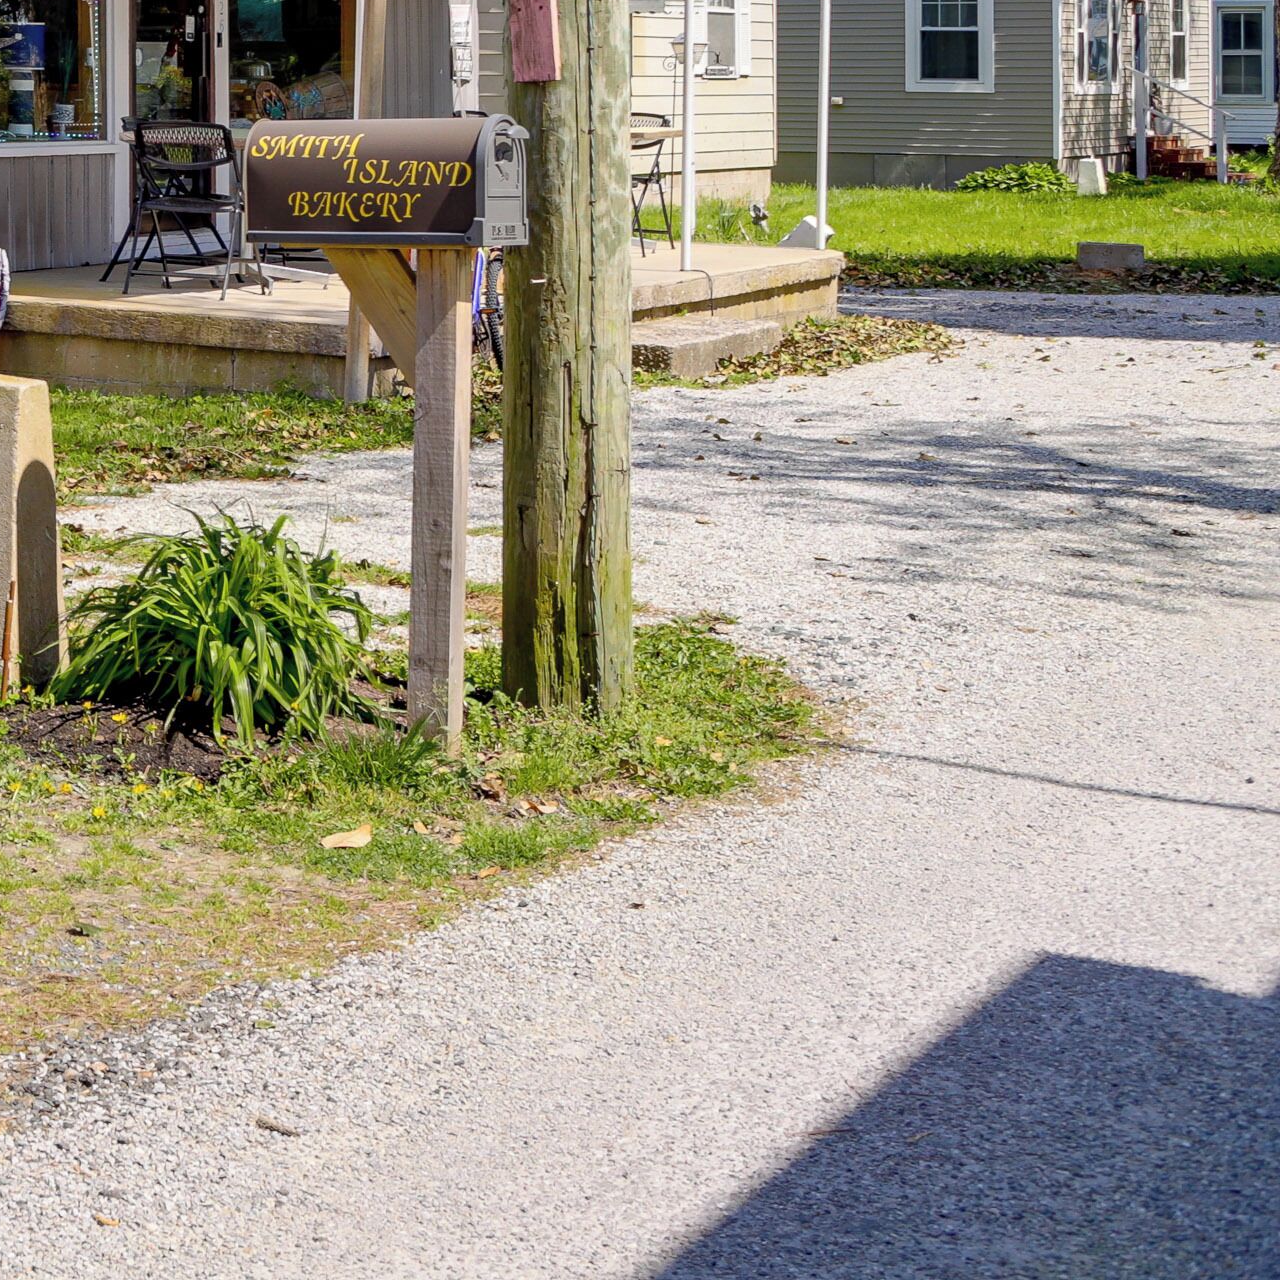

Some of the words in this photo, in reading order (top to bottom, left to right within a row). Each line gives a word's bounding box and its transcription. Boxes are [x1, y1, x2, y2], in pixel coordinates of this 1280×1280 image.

[251, 133, 365, 161] SMITH
[343, 158, 472, 187] ISLAND
[288, 191, 421, 223] BAKERY
